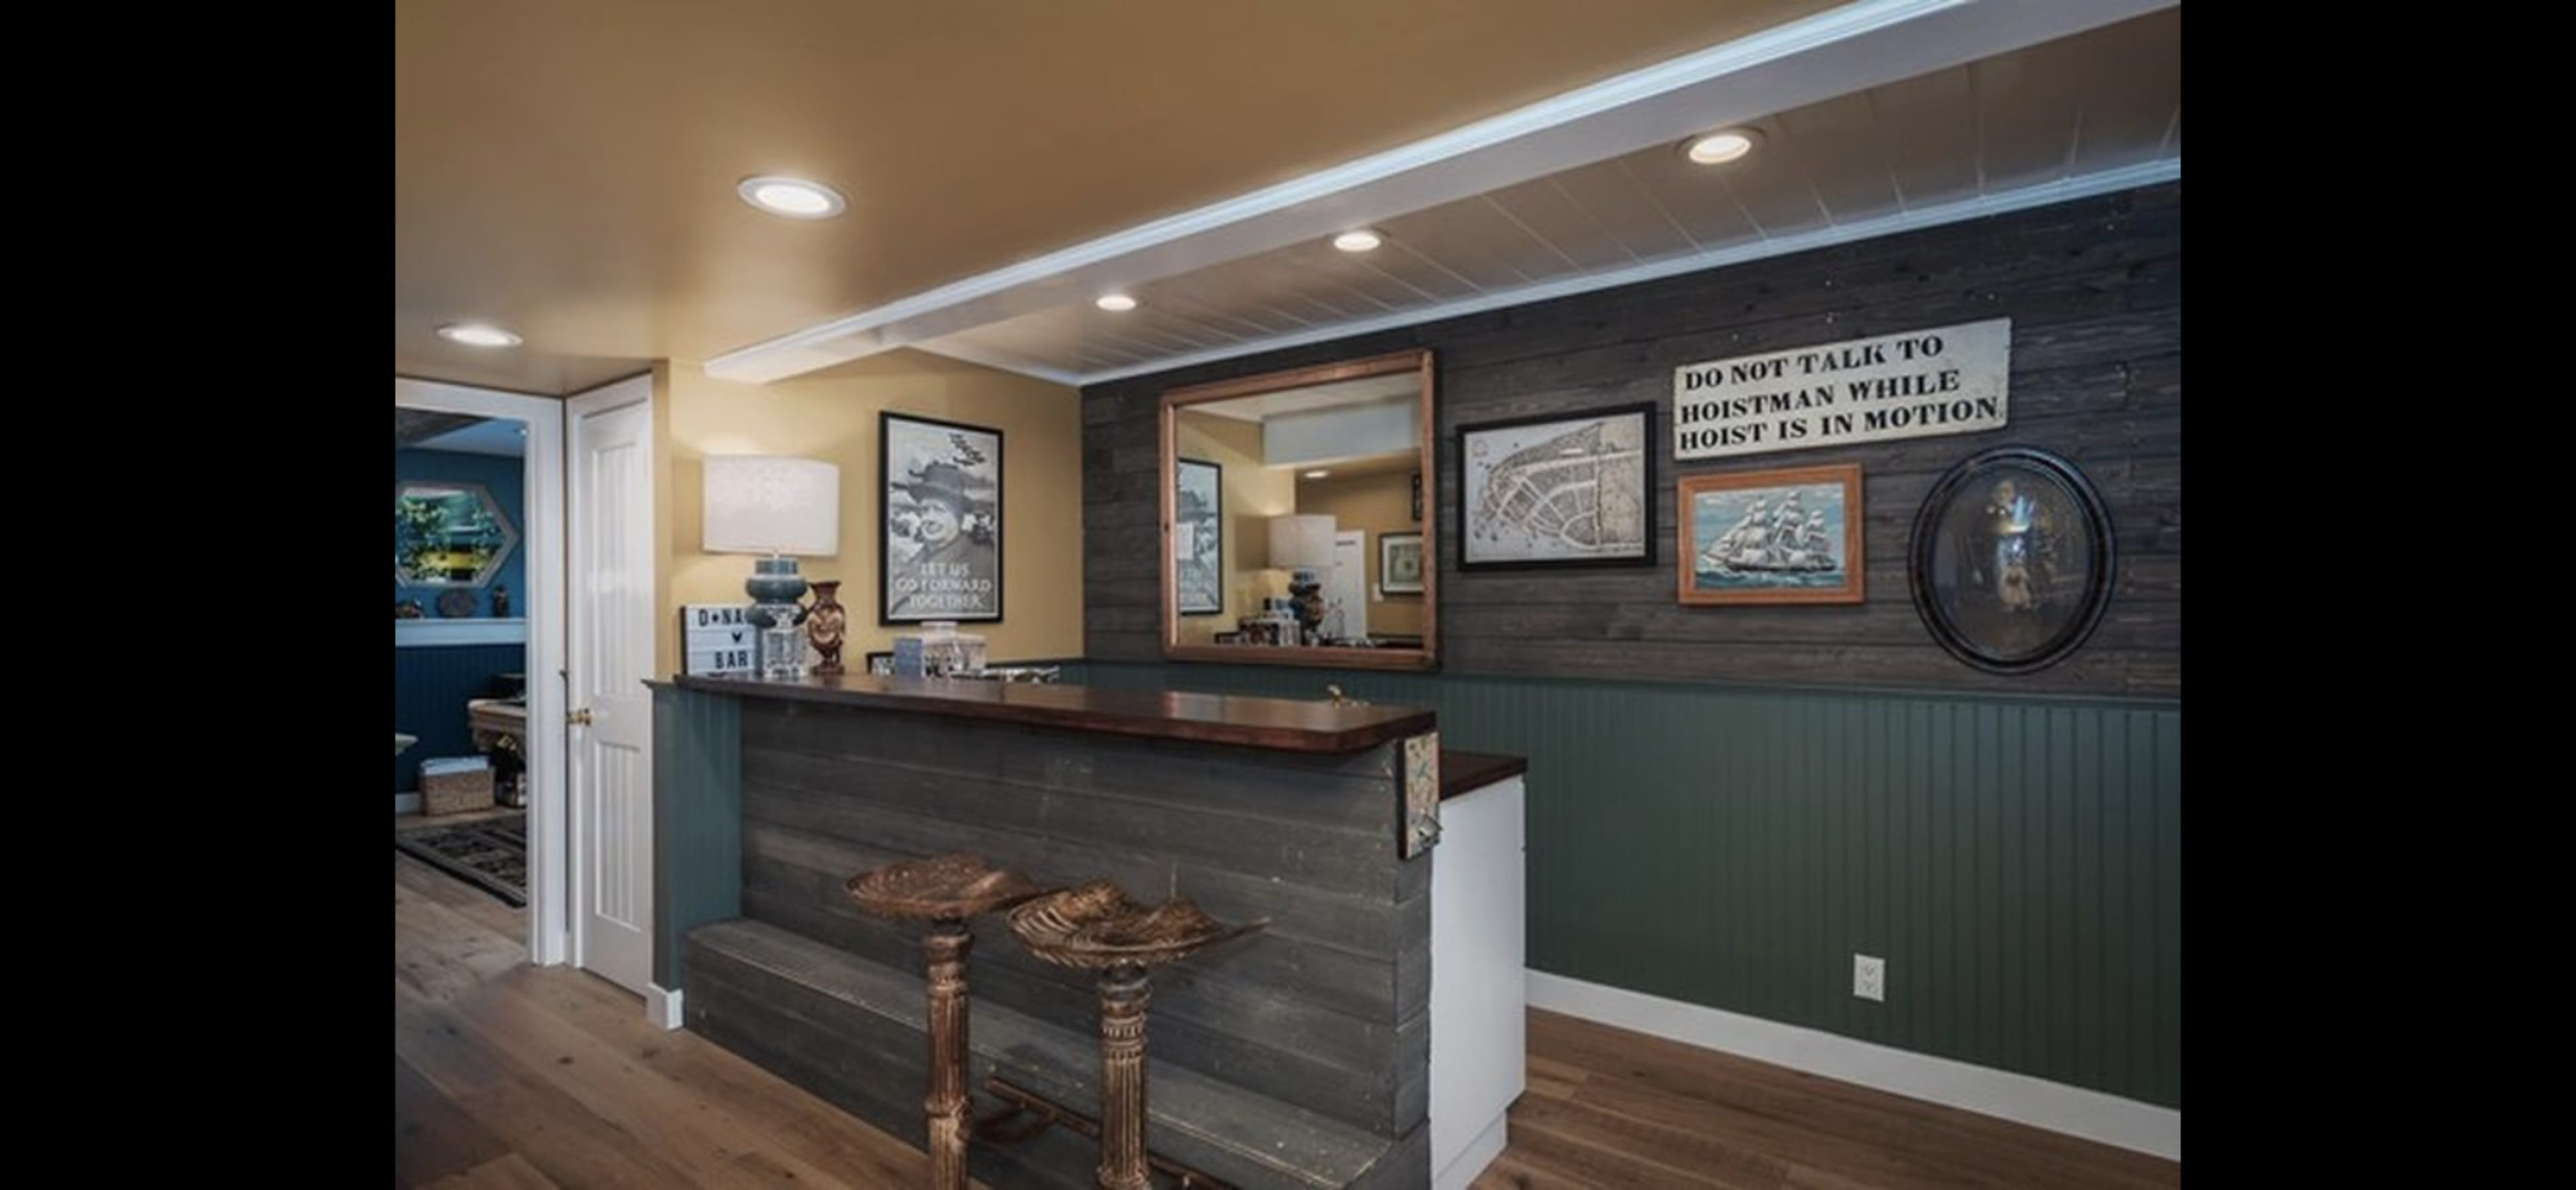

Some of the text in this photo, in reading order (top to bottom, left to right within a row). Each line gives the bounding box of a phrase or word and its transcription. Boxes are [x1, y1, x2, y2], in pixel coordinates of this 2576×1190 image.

[1685, 335, 1943, 390] DO NOT TALK TO
[1681, 369, 1960, 424] HOISTMAN WHILE
[1680, 397, 1999, 451] HOIST IS IN MOTION
[716, 651, 748, 669] BAR
